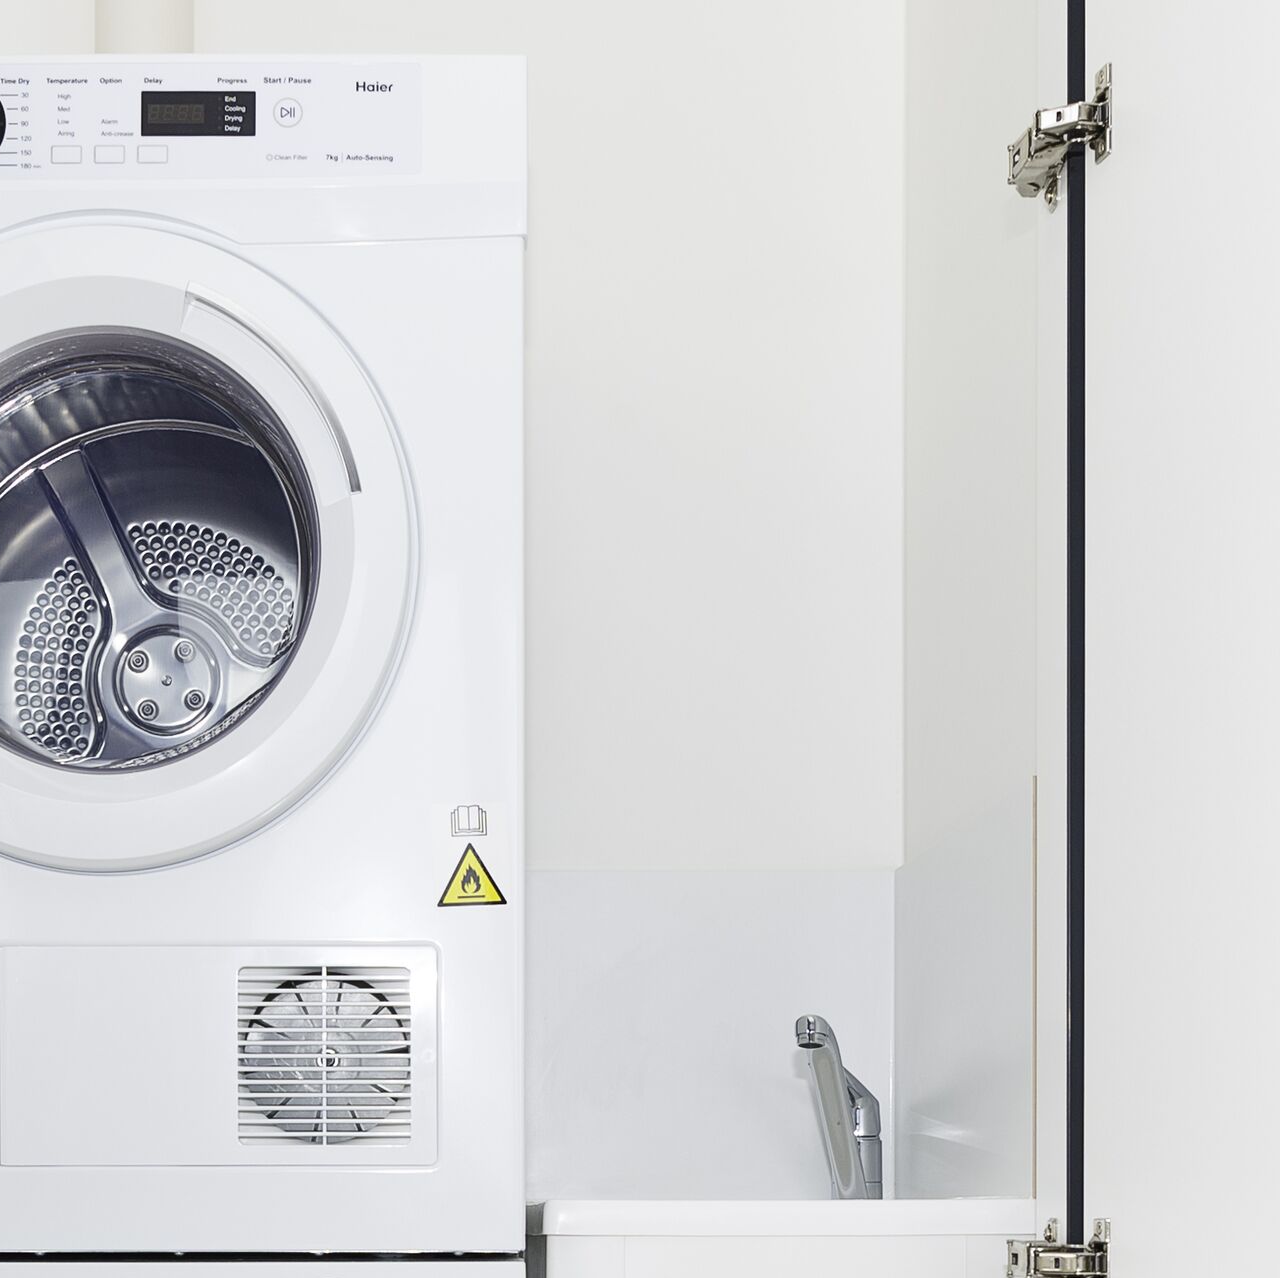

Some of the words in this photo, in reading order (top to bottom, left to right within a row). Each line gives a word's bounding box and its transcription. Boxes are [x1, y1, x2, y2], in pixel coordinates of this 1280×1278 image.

[144, 77, 163, 85] Delay
[217, 77, 247, 85] Progress
[355, 81, 393, 92] Haier
[224, 95, 237, 103] End
[224, 105, 246, 113] Cooling
[224, 115, 243, 123] Drying
[224, 124, 241, 133] Delay
[326, 154, 339, 162] 7kg
[346, 154, 394, 163] Auto-Sensing
